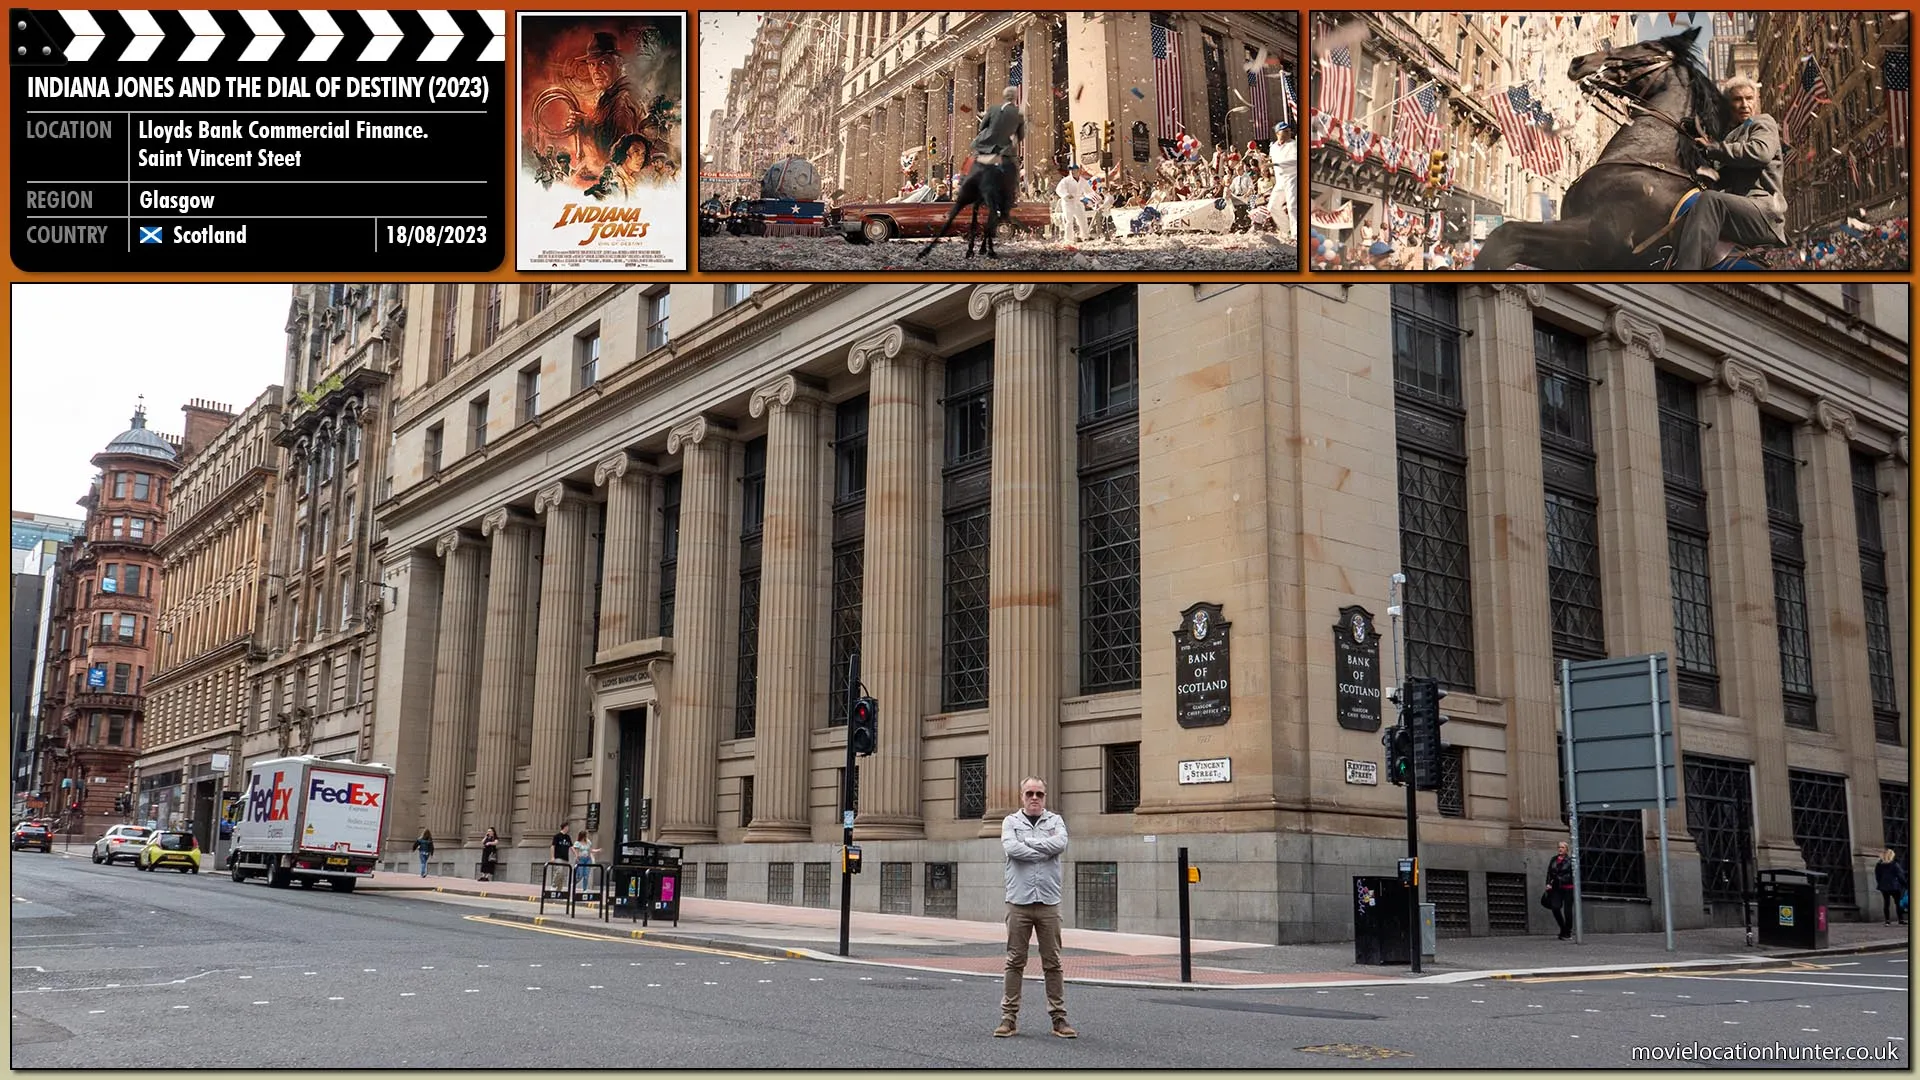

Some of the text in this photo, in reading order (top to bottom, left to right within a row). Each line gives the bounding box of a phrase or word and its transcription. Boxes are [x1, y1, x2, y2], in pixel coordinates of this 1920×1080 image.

[553, 203, 642, 230] INDIANA
[578, 222, 650, 246] JONES
[1188, 651, 1216, 664] BANK
[1347, 655, 1370, 668] BANK
[1194, 667, 1208, 678] OF
[1352, 670, 1364, 681] OF
[1177, 679, 1228, 695] SCOTLAND
[1339, 683, 1380, 698] SCOTLAND
[1195, 762, 1224, 770] VINCENT
[1191, 769, 1217, 778] STREET
[248, 771, 293, 823] FedEx
[309, 778, 380, 807] FedEx
